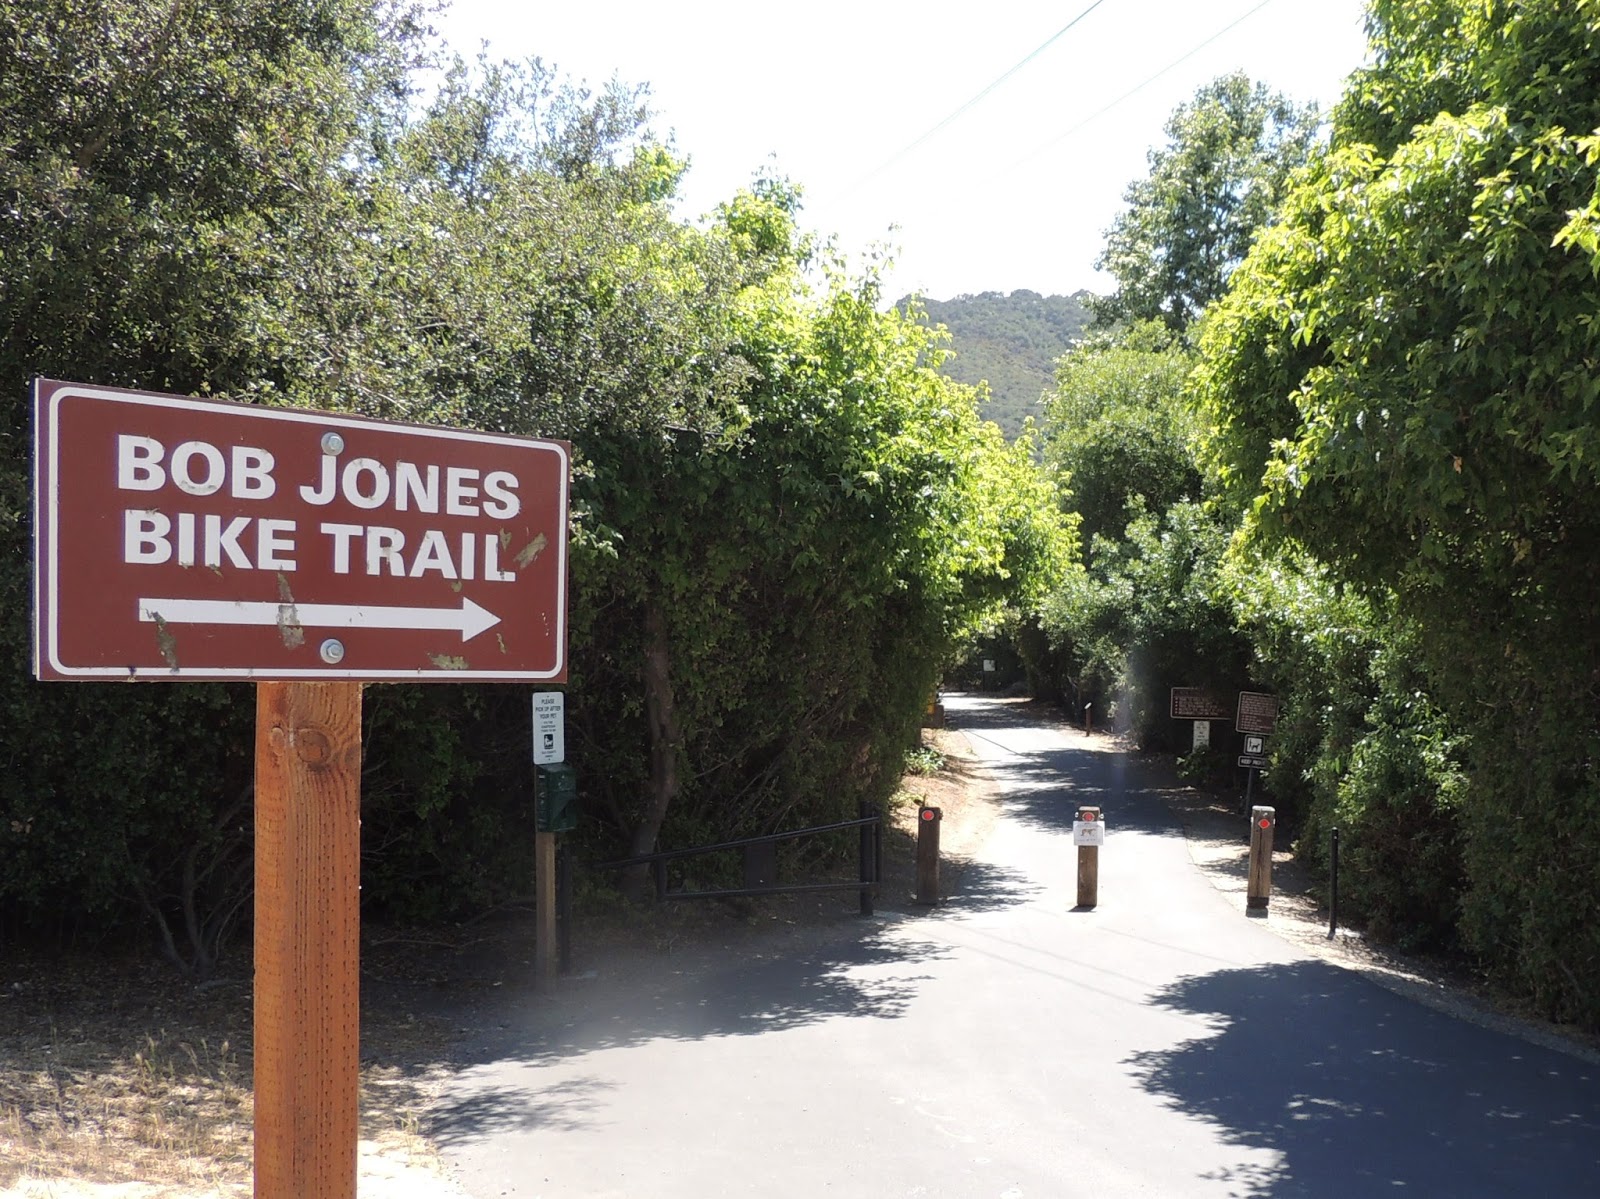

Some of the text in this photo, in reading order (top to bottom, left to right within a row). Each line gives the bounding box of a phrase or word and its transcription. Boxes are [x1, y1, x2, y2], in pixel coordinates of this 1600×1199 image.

[117, 433, 521, 521] BOB JONES
[123, 508, 517, 583] BIKE TRAIL
